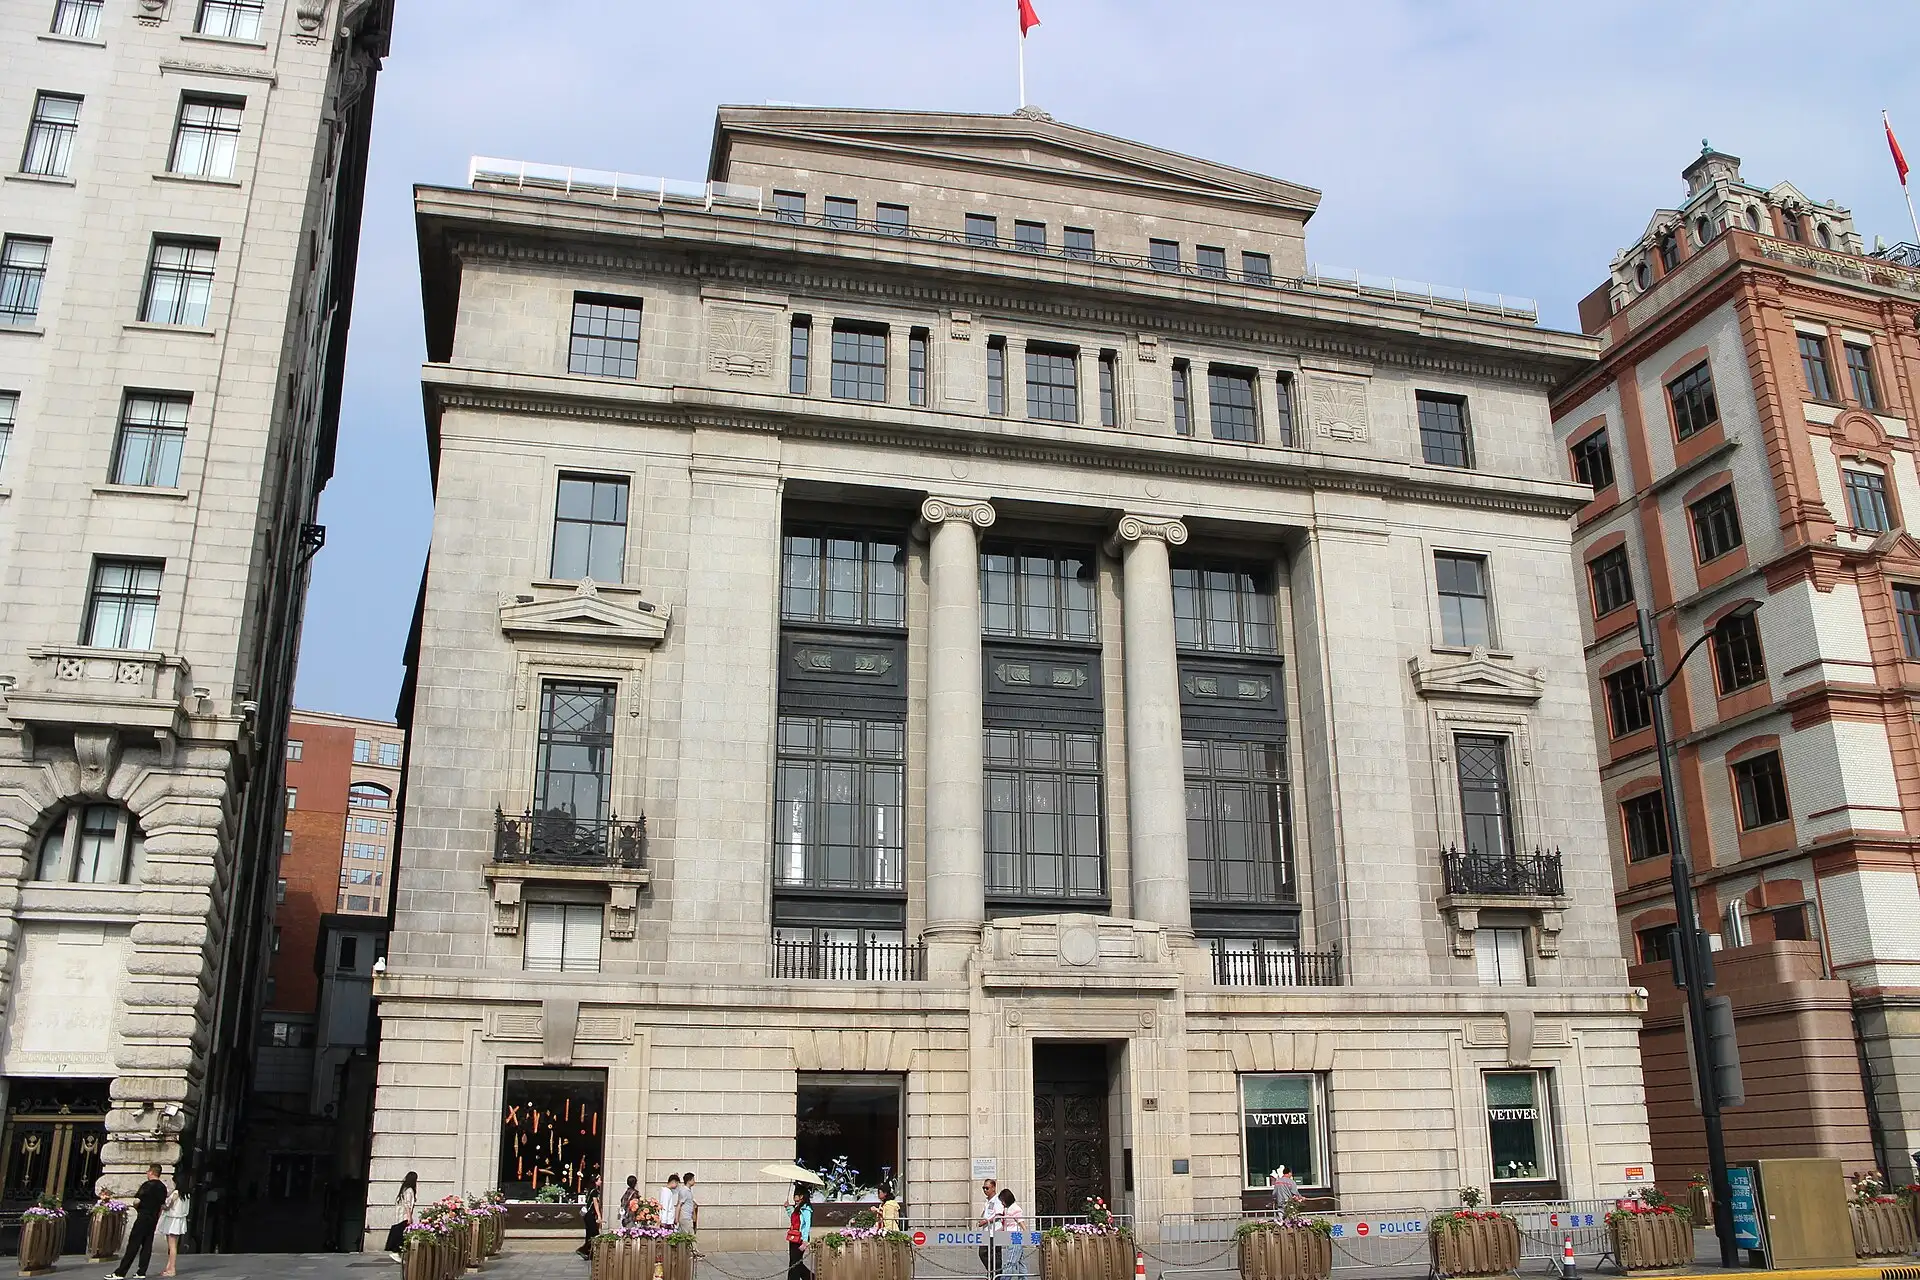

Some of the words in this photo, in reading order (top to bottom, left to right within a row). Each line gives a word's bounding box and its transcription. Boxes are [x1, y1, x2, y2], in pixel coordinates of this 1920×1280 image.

[1753, 236, 1790, 254] THE
[1795, 246, 1869, 273] SWATCH
[1875, 264, 1908, 281] ART
[57, 1064, 67, 1072] 17
[1252, 1113, 1308, 1125] VETIVER
[1489, 1109, 1539, 1120] VETIVER
[1570, 1214, 1594, 1227] 警察
[1379, 1221, 1421, 1233] POLICE
[938, 1233, 982, 1244] POLICE
[1010, 1231, 1041, 1245] 警察
